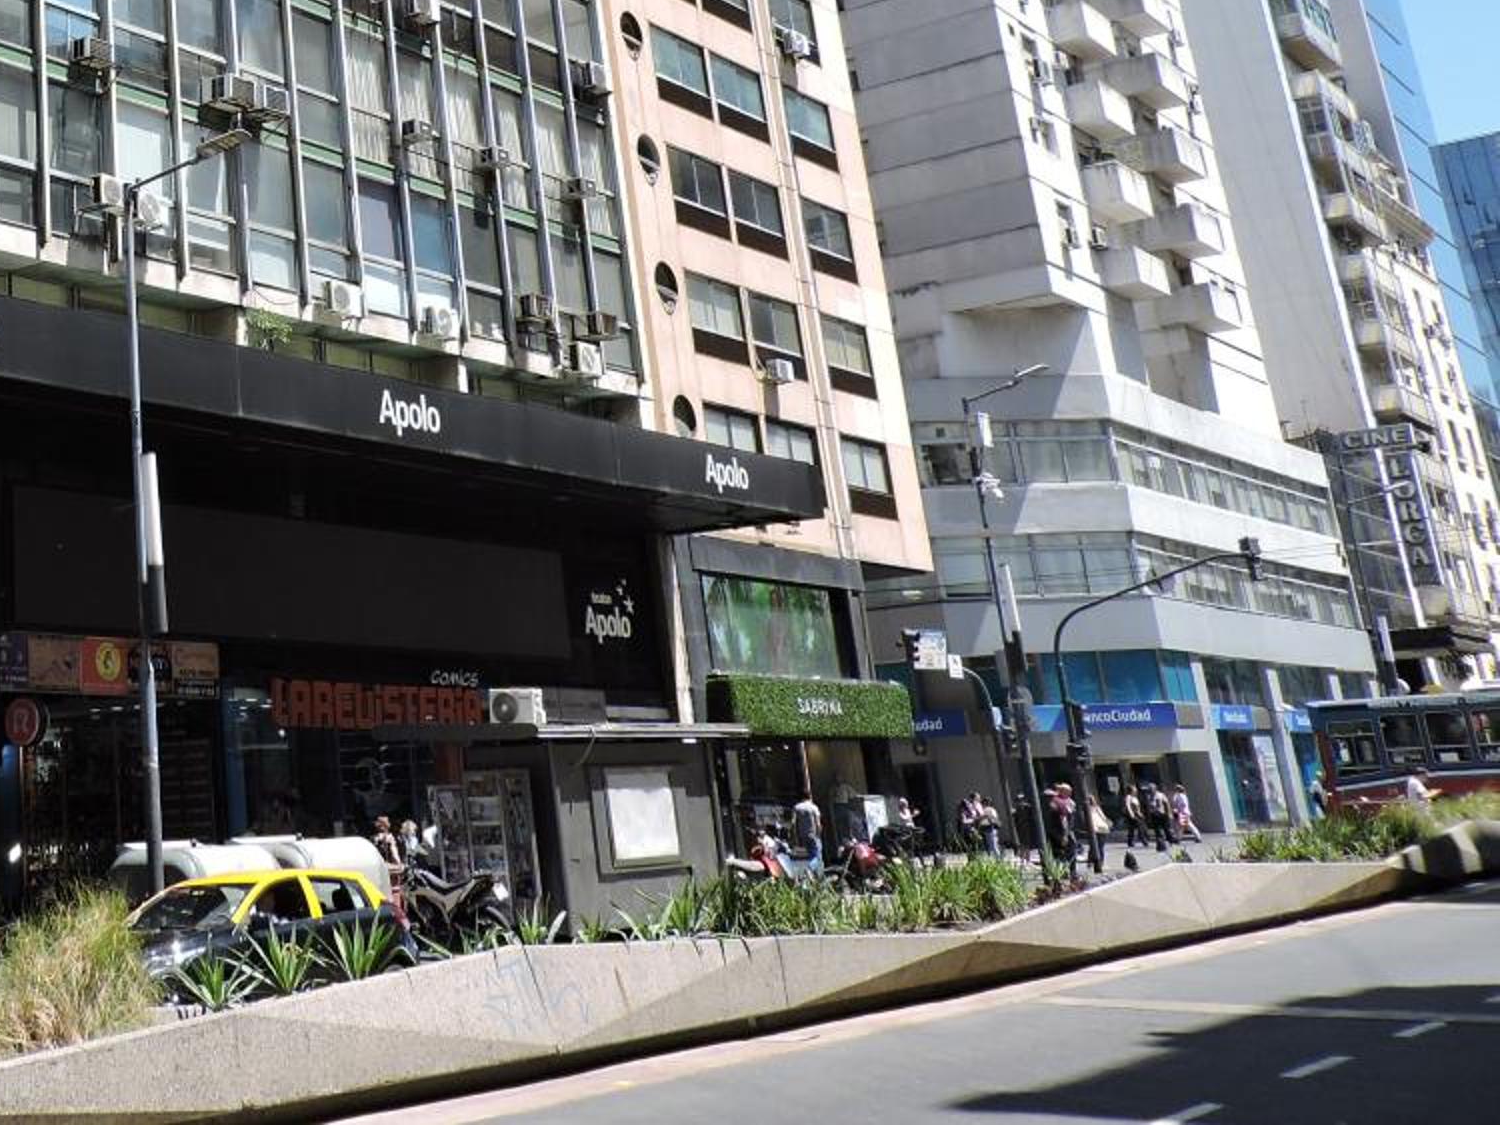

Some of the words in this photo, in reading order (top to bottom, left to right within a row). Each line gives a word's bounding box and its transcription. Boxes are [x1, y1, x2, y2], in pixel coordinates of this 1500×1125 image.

[379, 389, 441, 436] Apolo
[1344, 428, 1406, 448] CINE
[706, 454, 750, 490] Apolo
[1389, 458, 1430, 566] LORCA
[585, 604, 631, 644] Apolo
[1084, 707, 1151, 724] ancoCiudad
